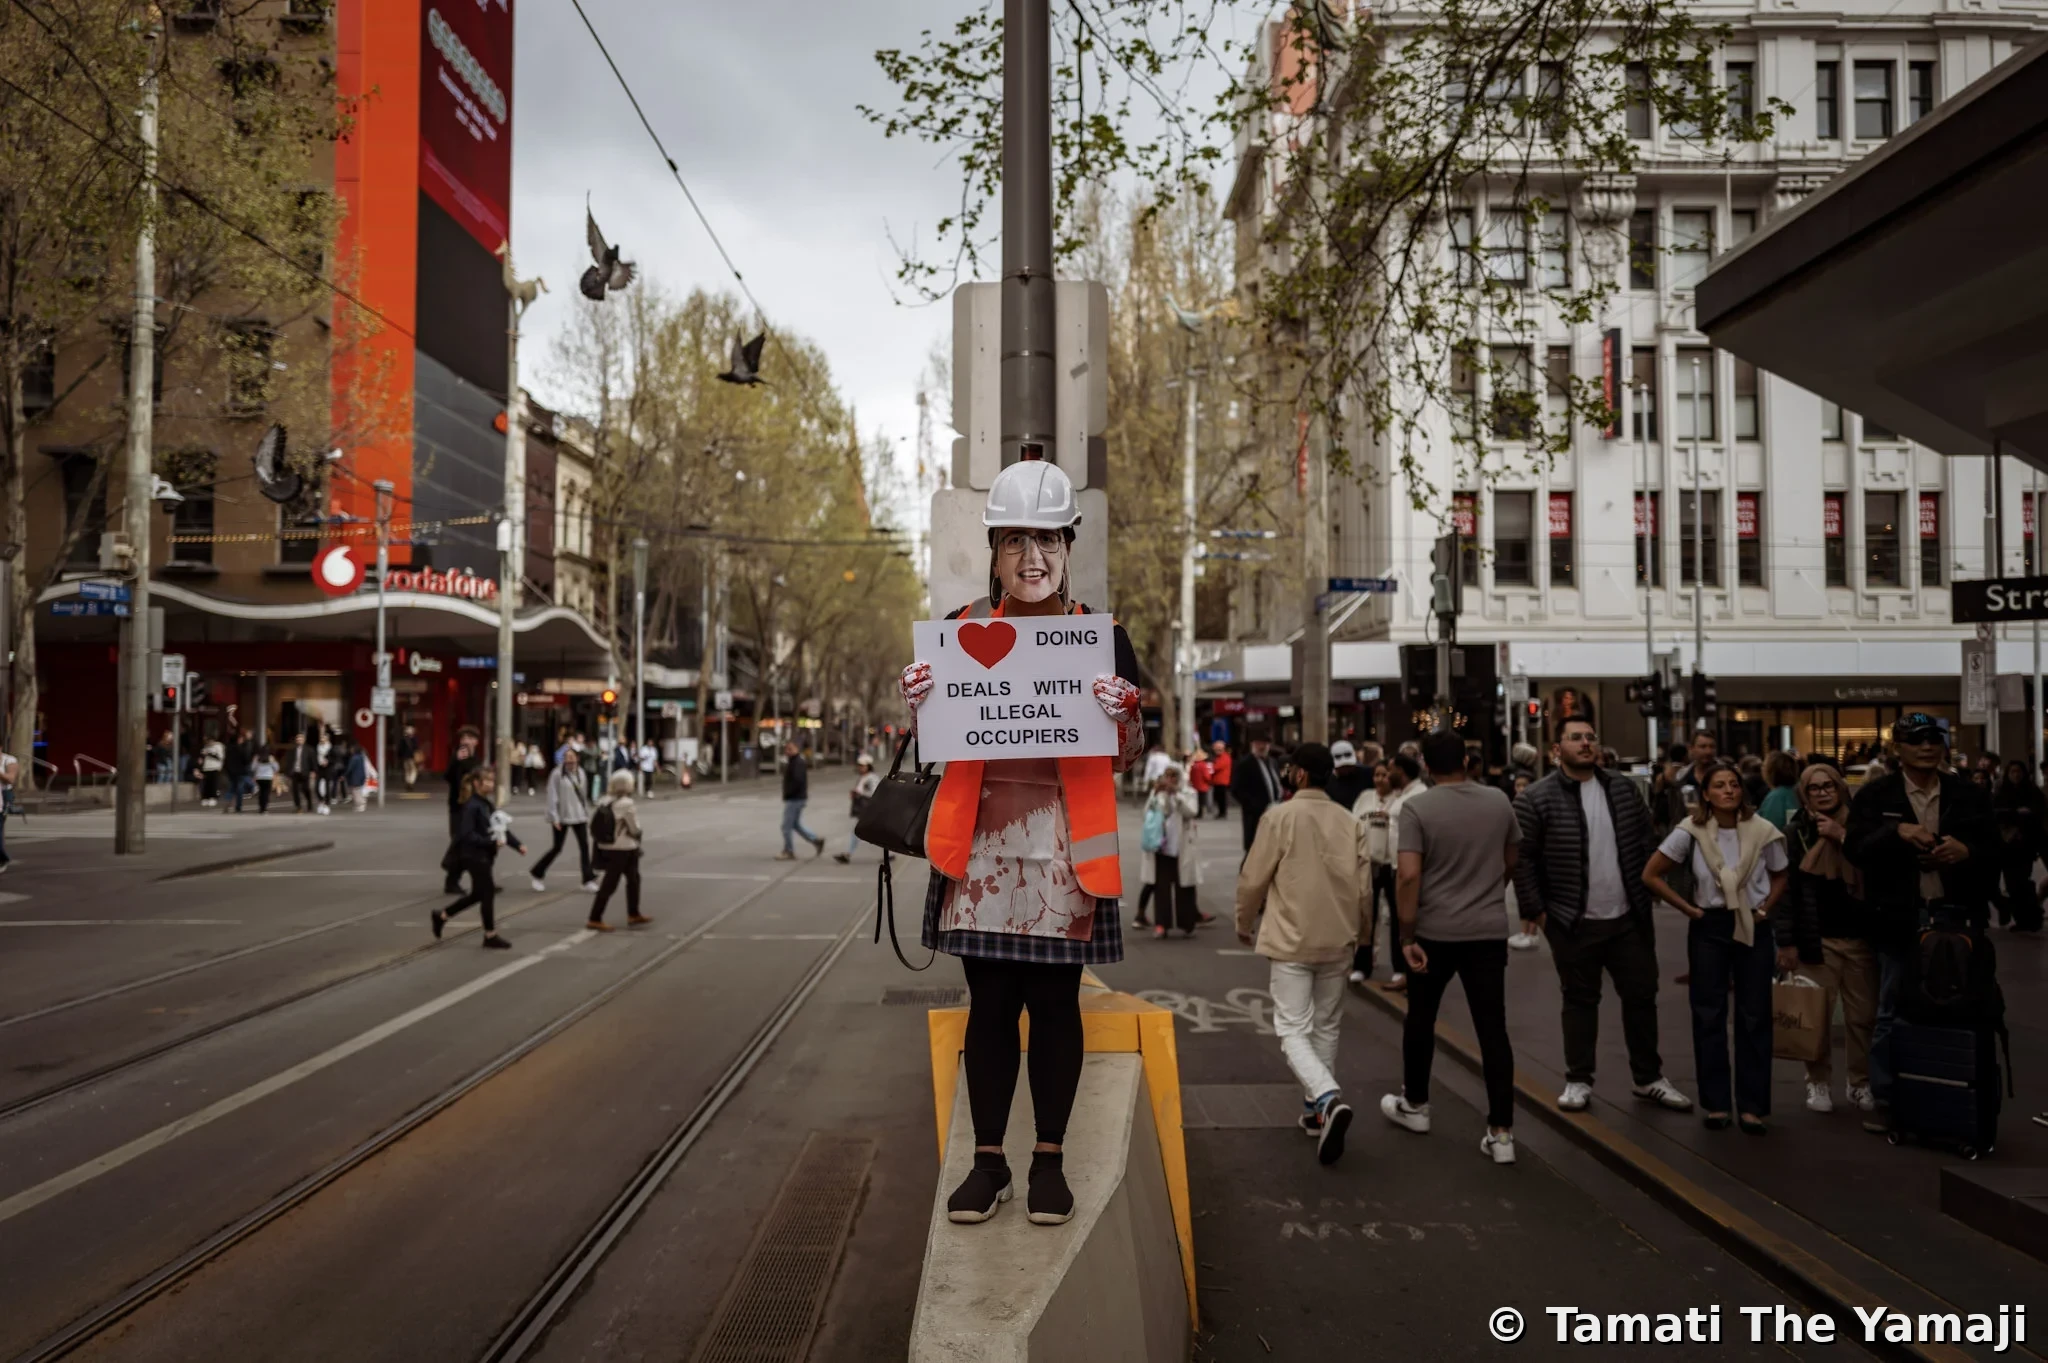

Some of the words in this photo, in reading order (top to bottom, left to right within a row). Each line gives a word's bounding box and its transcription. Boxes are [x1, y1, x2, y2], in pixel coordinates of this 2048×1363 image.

[940, 632, 944, 648] I
[1036, 630, 1097, 645] DOING
[948, 681, 1010, 697] DEALS
[1034, 680, 1081, 695] WITH
[981, 704, 1061, 720] ILLEGAL
[966, 729, 1078, 745] OCCUPIERS
